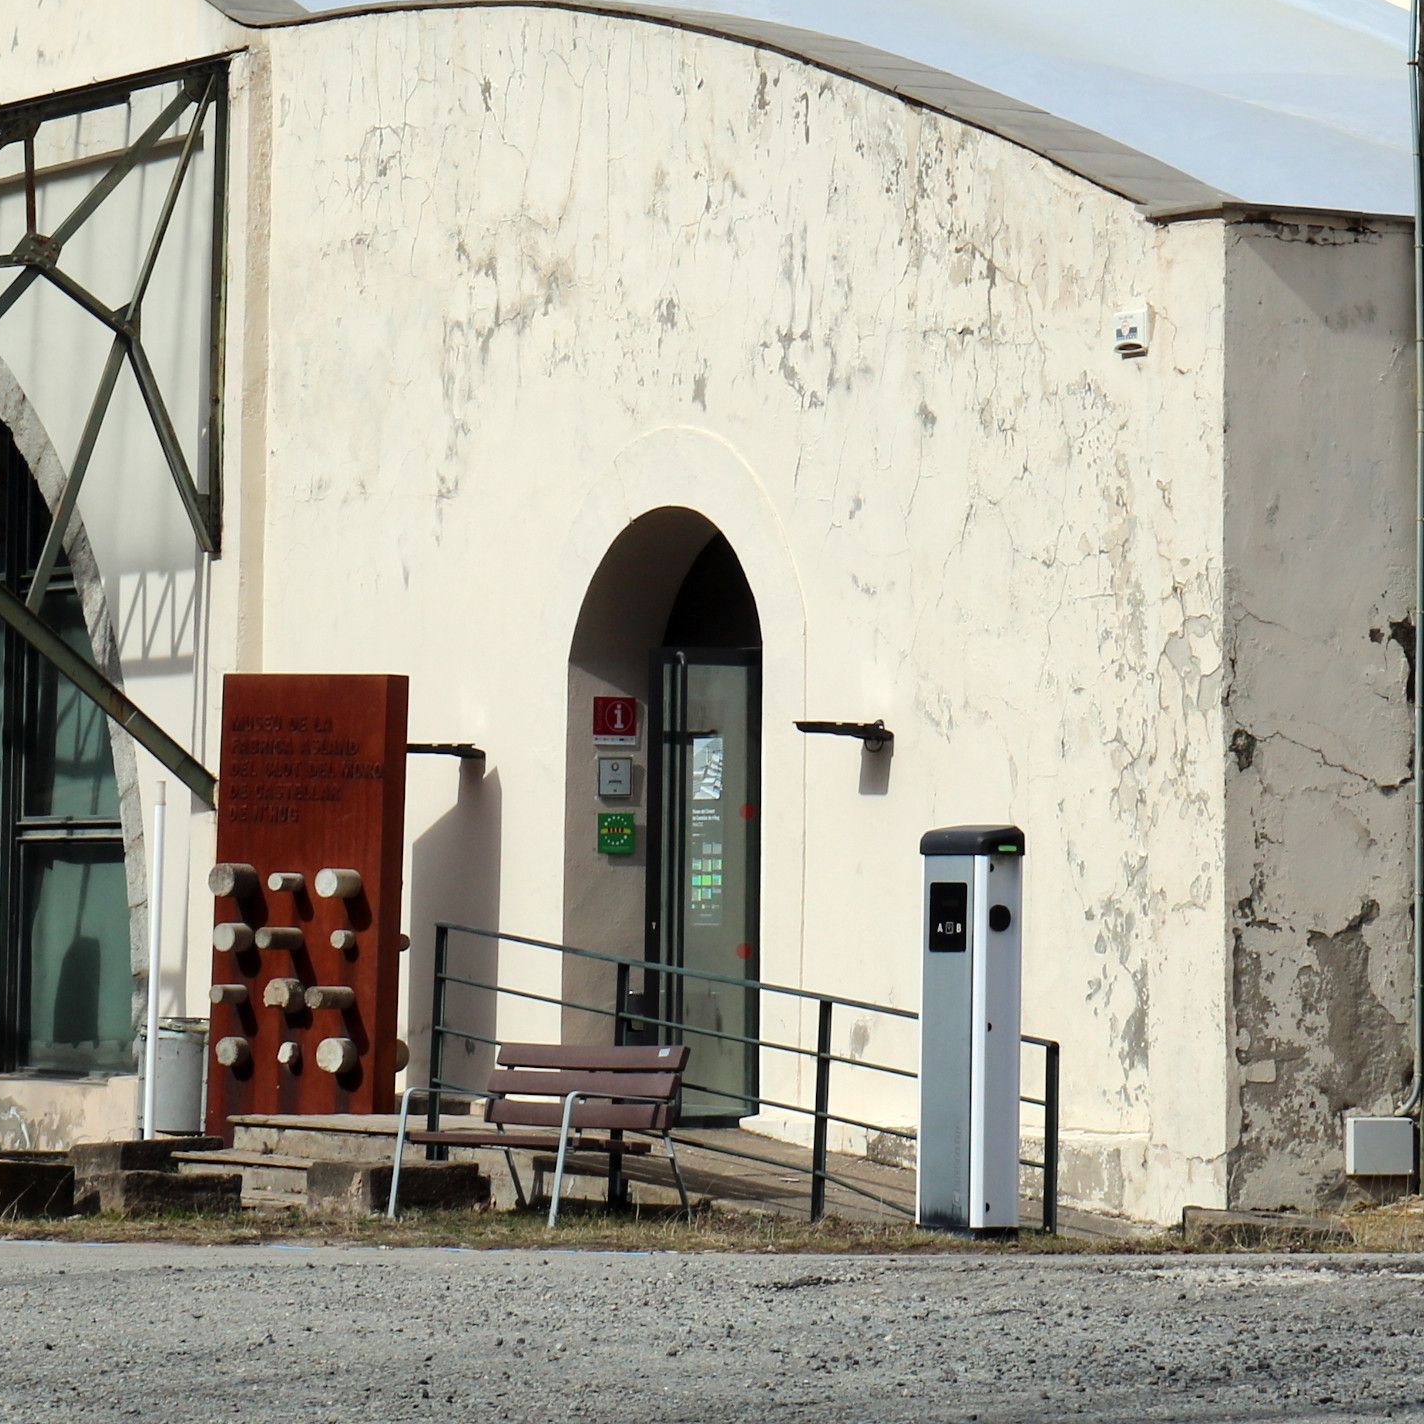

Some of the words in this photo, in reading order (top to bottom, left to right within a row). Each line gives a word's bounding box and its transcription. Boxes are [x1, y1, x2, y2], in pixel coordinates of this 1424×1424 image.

[231, 714, 282, 732] MUSEU
[289, 716, 308, 733] DE
[314, 715, 333, 733] LA
[231, 761, 258, 778] DEL
[308, 762, 334, 778] DEL
[230, 783, 249, 801] DE
[256, 783, 342, 801] CASTELLAR
[229, 804, 249, 822] DE
[937, 923, 943, 933] A
[956, 923, 962, 933] B
